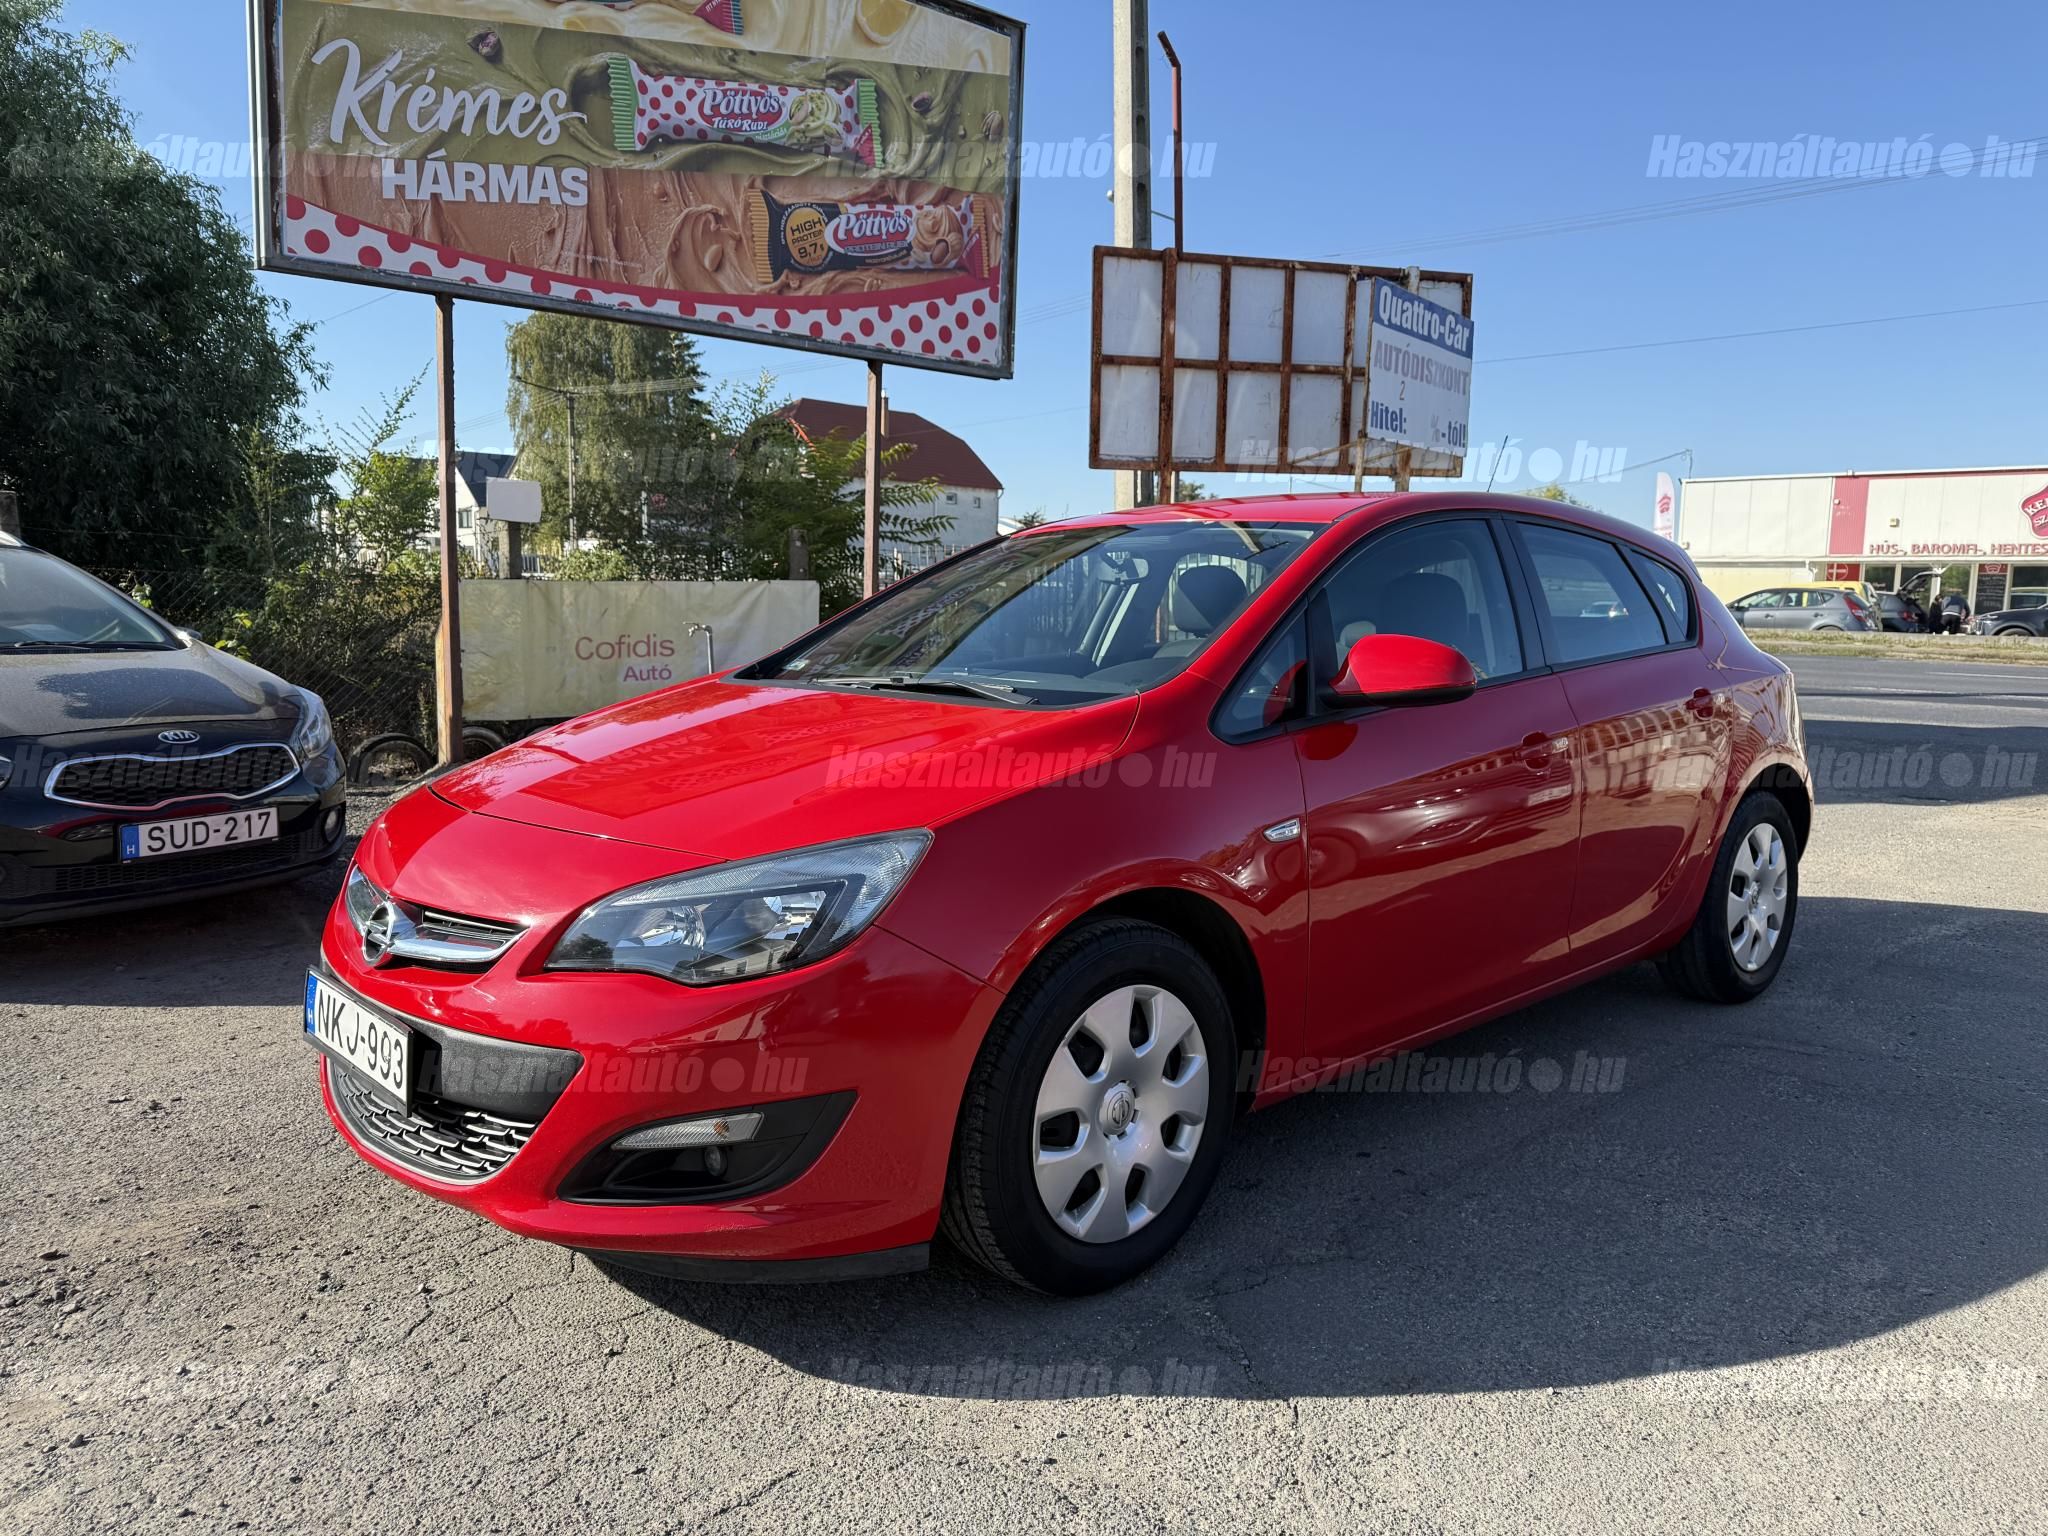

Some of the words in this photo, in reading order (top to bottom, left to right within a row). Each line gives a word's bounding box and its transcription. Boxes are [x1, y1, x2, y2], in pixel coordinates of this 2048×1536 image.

[311, 38, 587, 146] Krémes
[703, 87, 781, 119] Pöttyös
[382, 148, 589, 206] HÁRMAS
[790, 217, 823, 237] HIGH
[837, 211, 908, 240] Pöttyös
[1379, 285, 1470, 352] Quattro-Car
[1373, 341, 1470, 397] AUTÓDISZKONT
[1370, 400, 1408, 435] Hitel:
[575, 634, 676, 661] Cofidis
[623, 663, 673, 683] Autó
[163, 730, 196, 743] KIA
[146, 811, 272, 853] SUD-217
[318, 988, 404, 1090] NKJ-993
